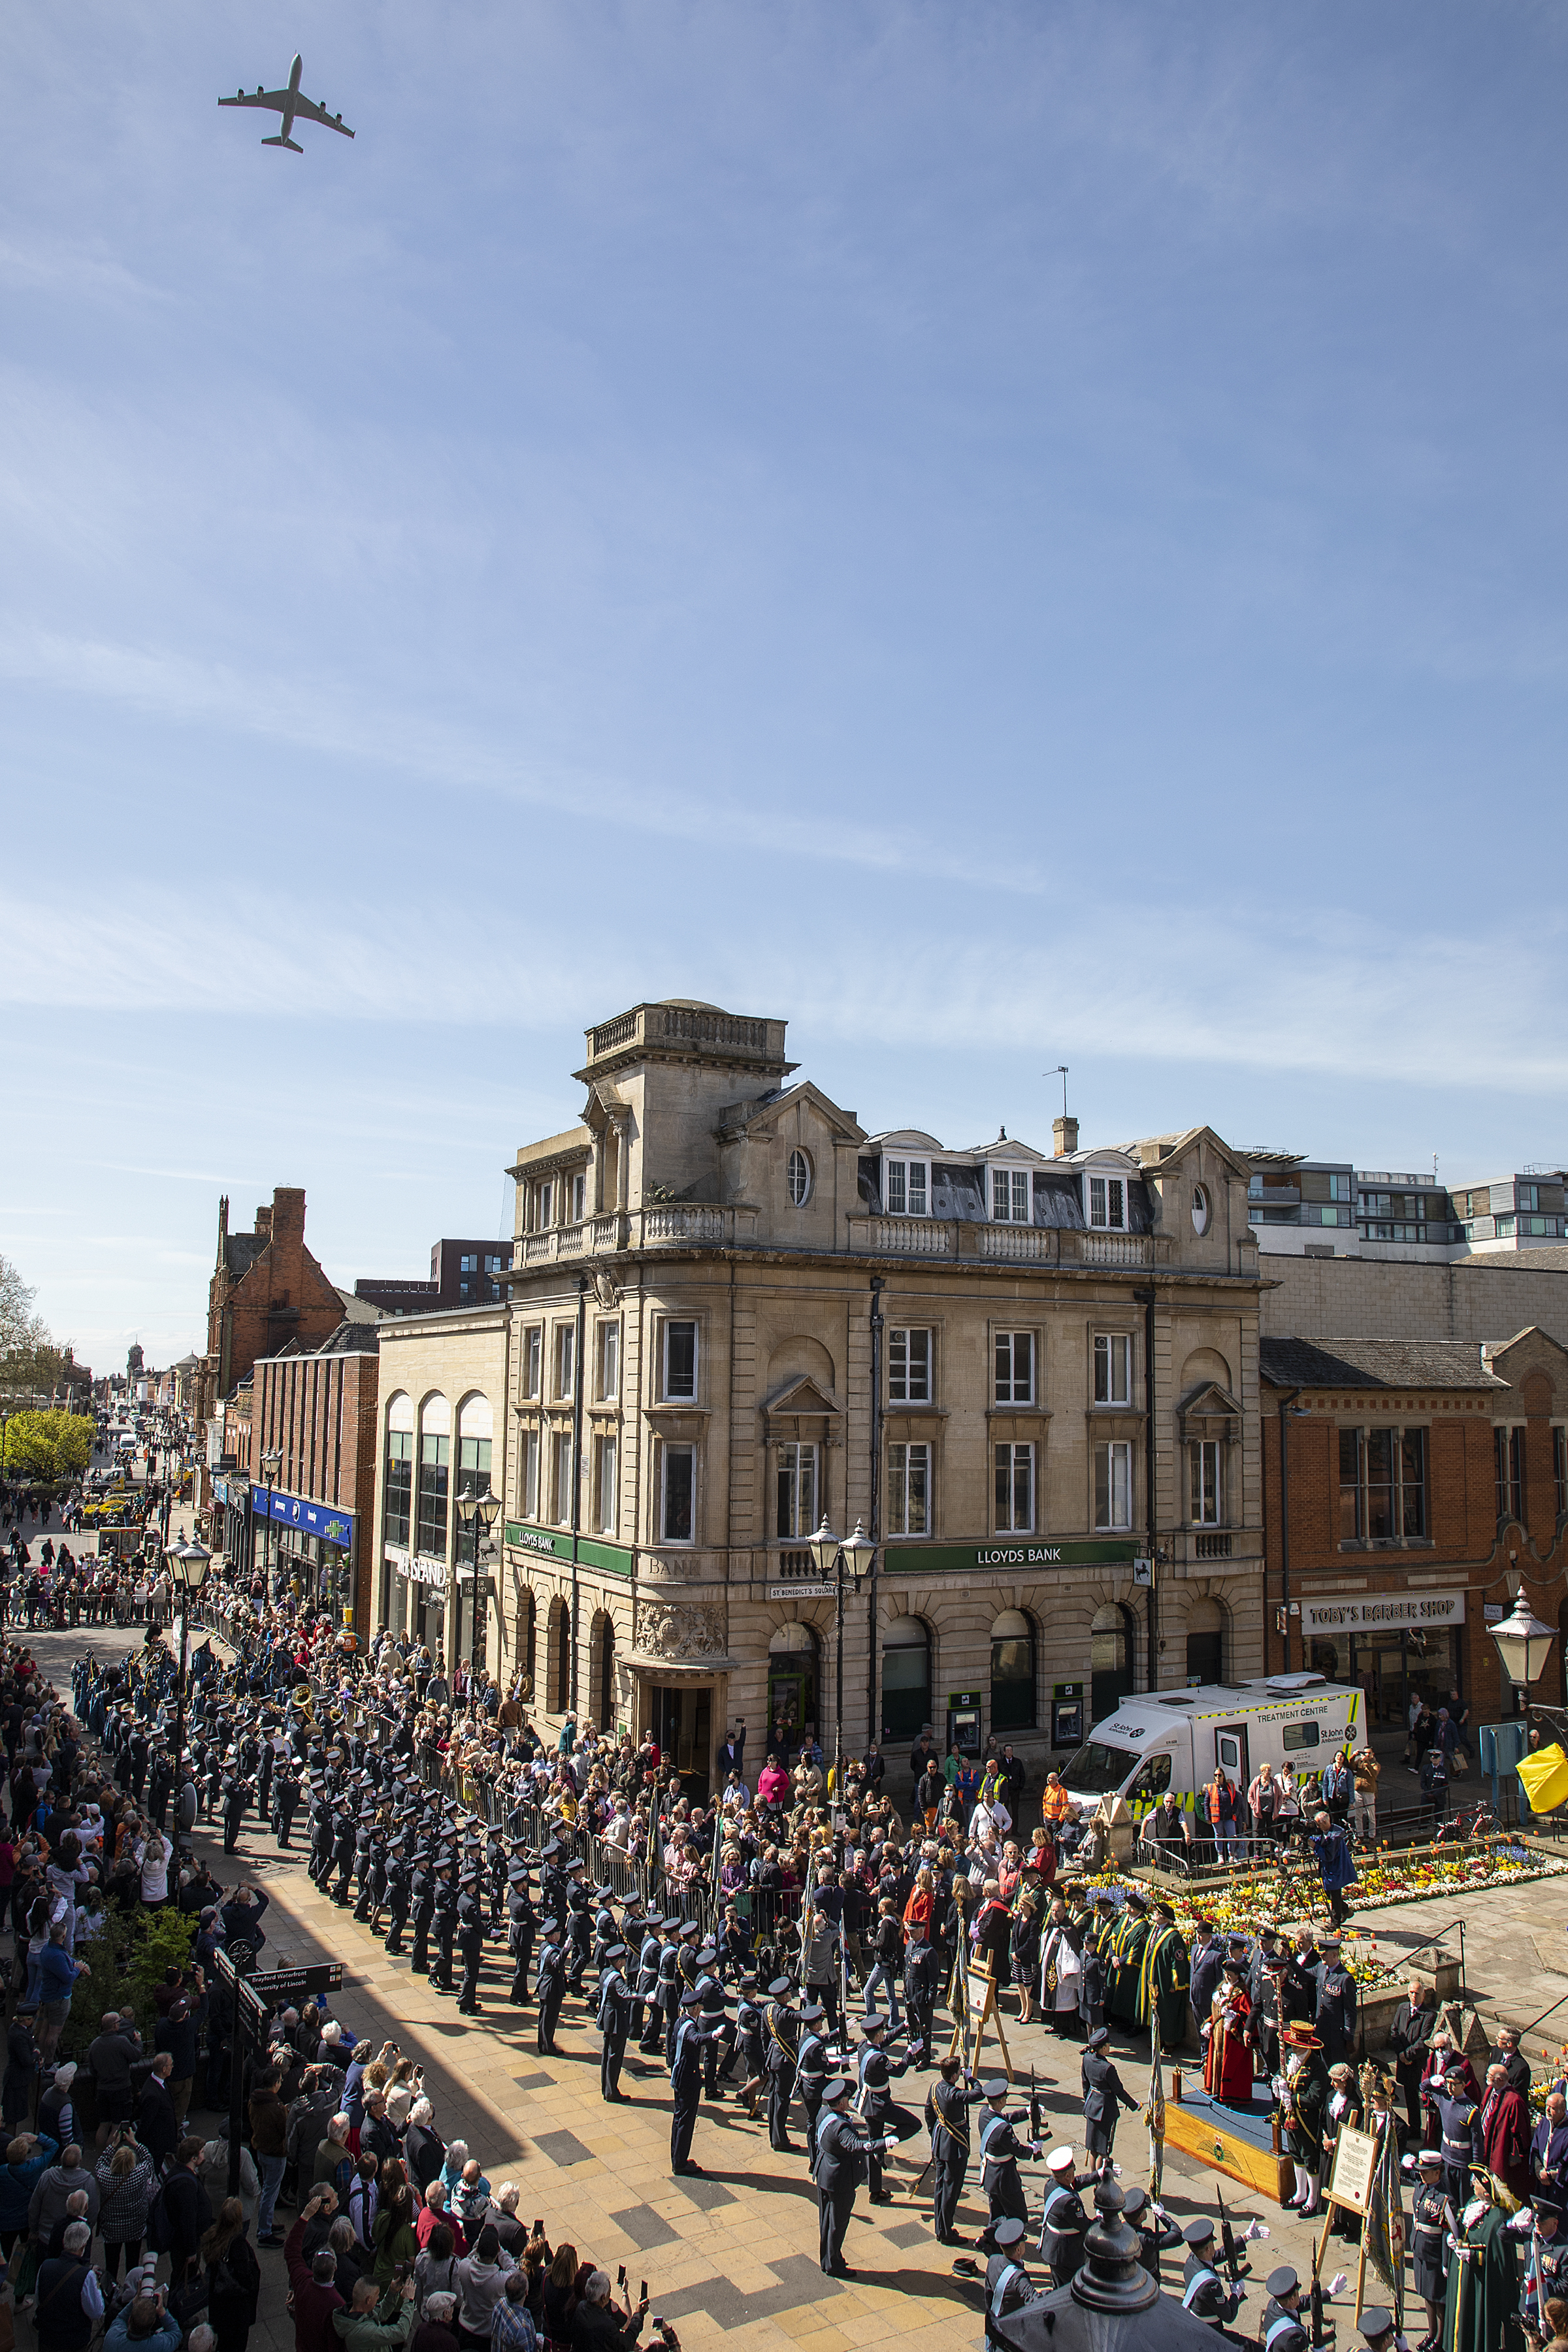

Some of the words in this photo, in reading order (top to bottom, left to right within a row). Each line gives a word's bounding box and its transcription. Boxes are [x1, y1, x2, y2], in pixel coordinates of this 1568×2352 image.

[519, 1531, 538, 1546] LLOYDS
[538, 1536, 553, 1551] BANK
[978, 1550, 1024, 1563] LLOYDS
[1028, 1548, 1061, 1561] BANK
[410, 1558, 447, 1587] ISLAND
[649, 1558, 700, 1575] BANK
[1311, 1606, 1359, 1624] TOBY'S
[1363, 1603, 1418, 1622] BARBER
[1420, 1600, 1456, 1617] SHOP
[1258, 1710, 1299, 1723] TREATMENT
[1300, 1706, 1328, 1716] CENTRE
[1328, 1729, 1343, 1737] John
[252, 1974, 276, 1983] Brayford
[277, 1971, 306, 1980] Waterfront
